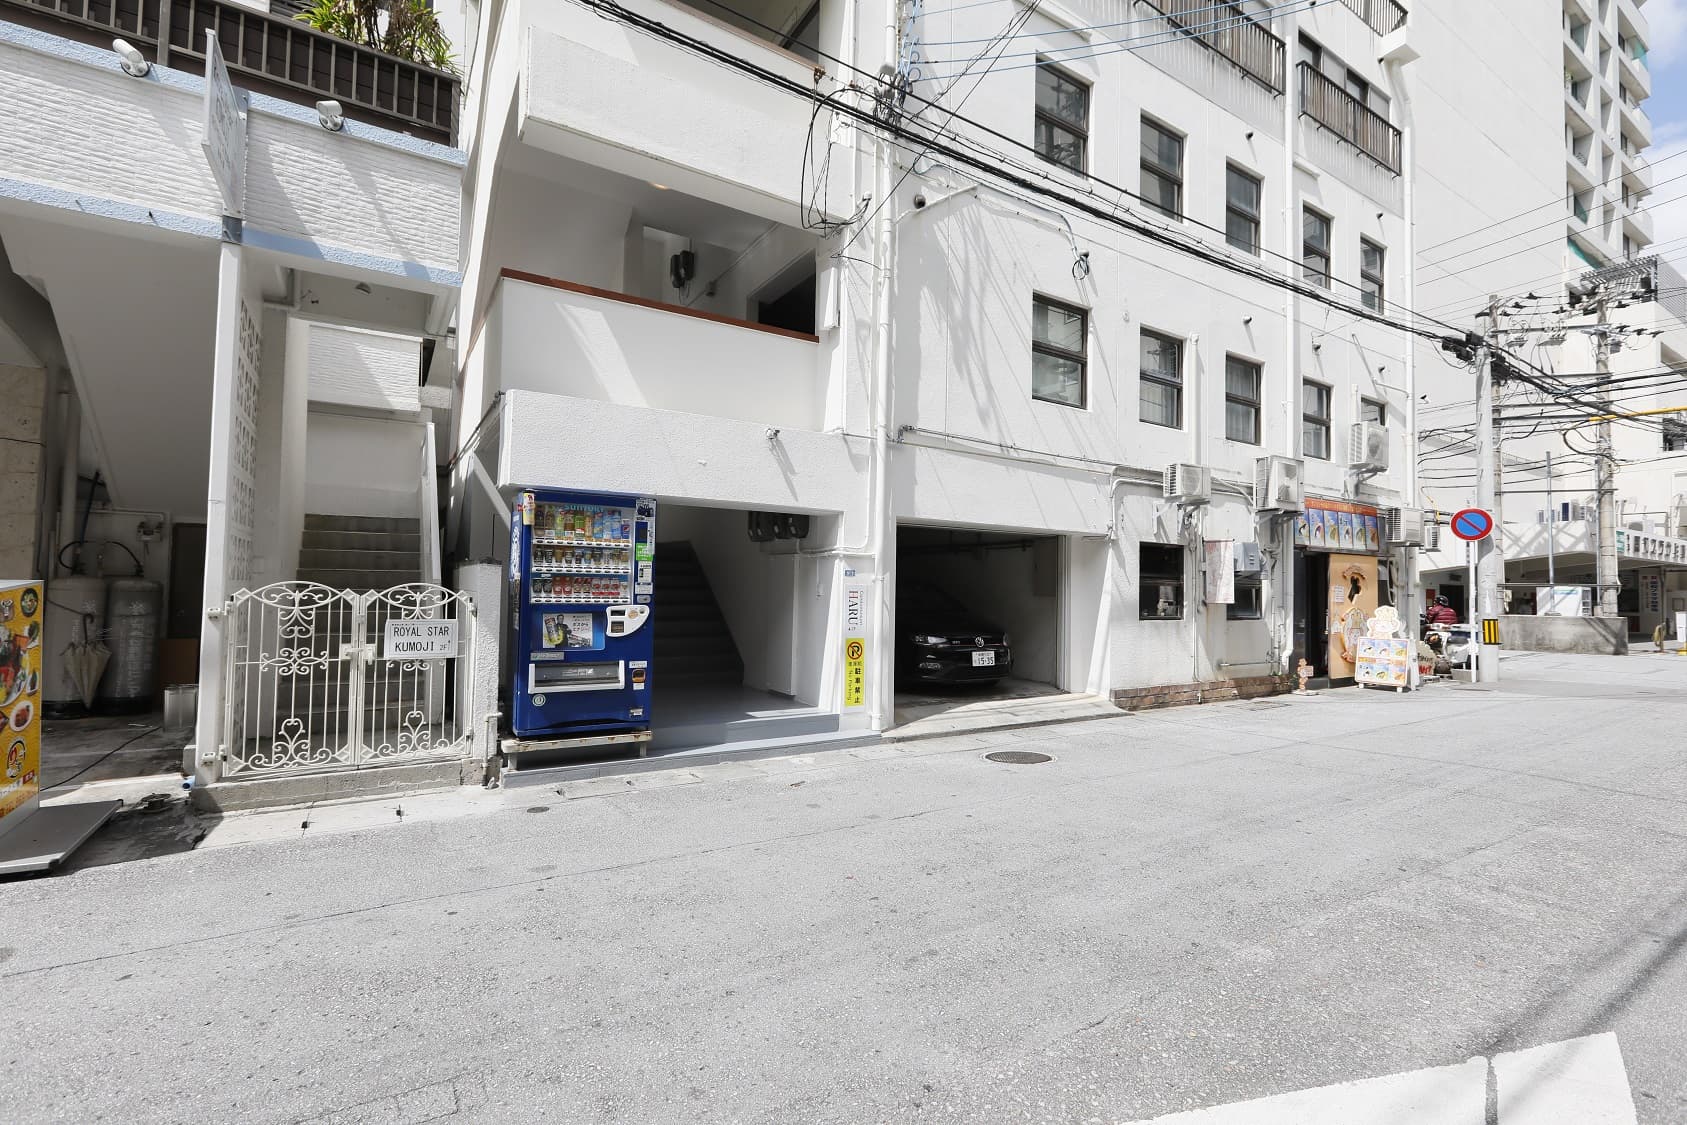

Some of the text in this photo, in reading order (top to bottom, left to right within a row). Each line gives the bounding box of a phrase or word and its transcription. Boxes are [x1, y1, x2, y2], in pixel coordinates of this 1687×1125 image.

[848, 590, 859, 625] HARU
[393, 626, 449, 637] ROYAL STAR
[394, 641, 434, 652] KUMOJI
